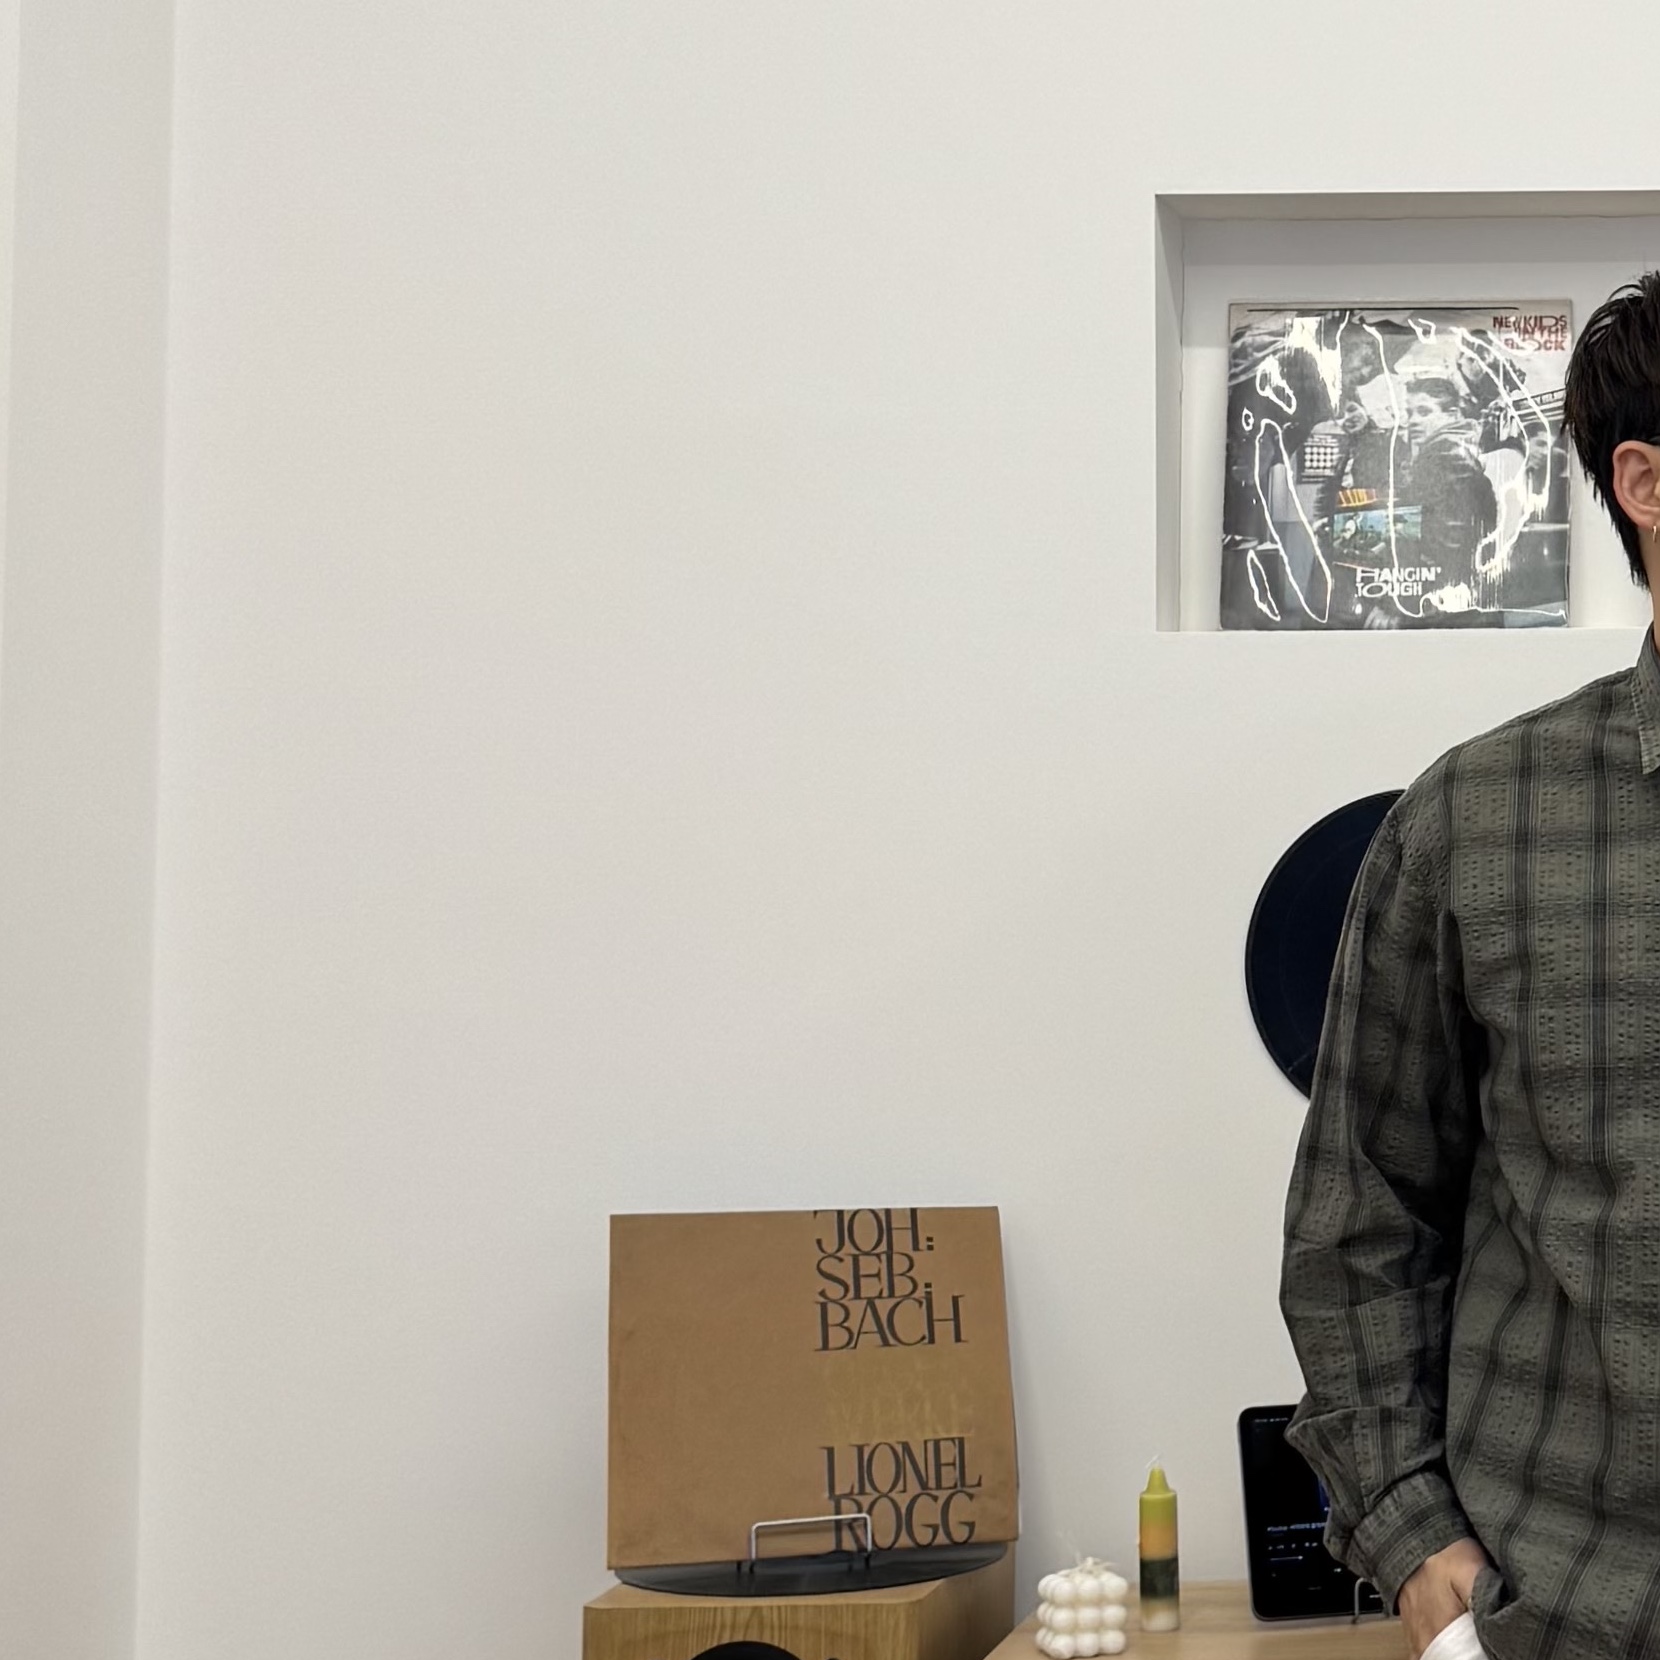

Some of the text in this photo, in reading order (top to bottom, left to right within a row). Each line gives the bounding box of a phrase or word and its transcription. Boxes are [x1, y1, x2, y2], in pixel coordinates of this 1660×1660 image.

[814, 1293, 969, 1352] BACH
[818, 1436, 983, 1496] LIONEL
[830, 1490, 977, 1553] ROGG
